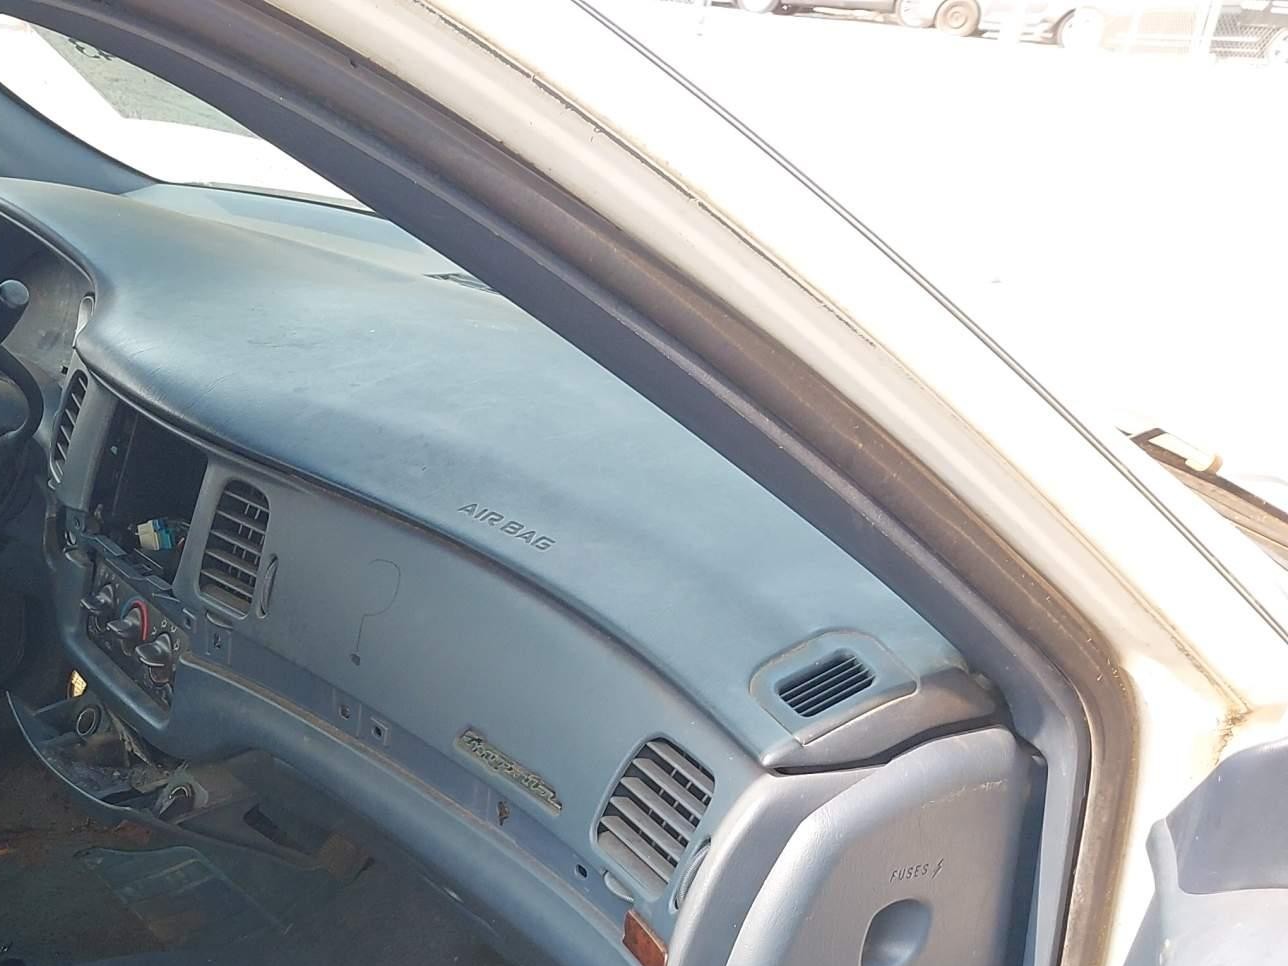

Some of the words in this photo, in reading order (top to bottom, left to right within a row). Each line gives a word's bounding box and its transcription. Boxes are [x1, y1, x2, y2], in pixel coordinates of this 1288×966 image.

[457, 503, 505, 527] AIR
[500, 520, 556, 550] BAG
[889, 862, 929, 883] FUSES
